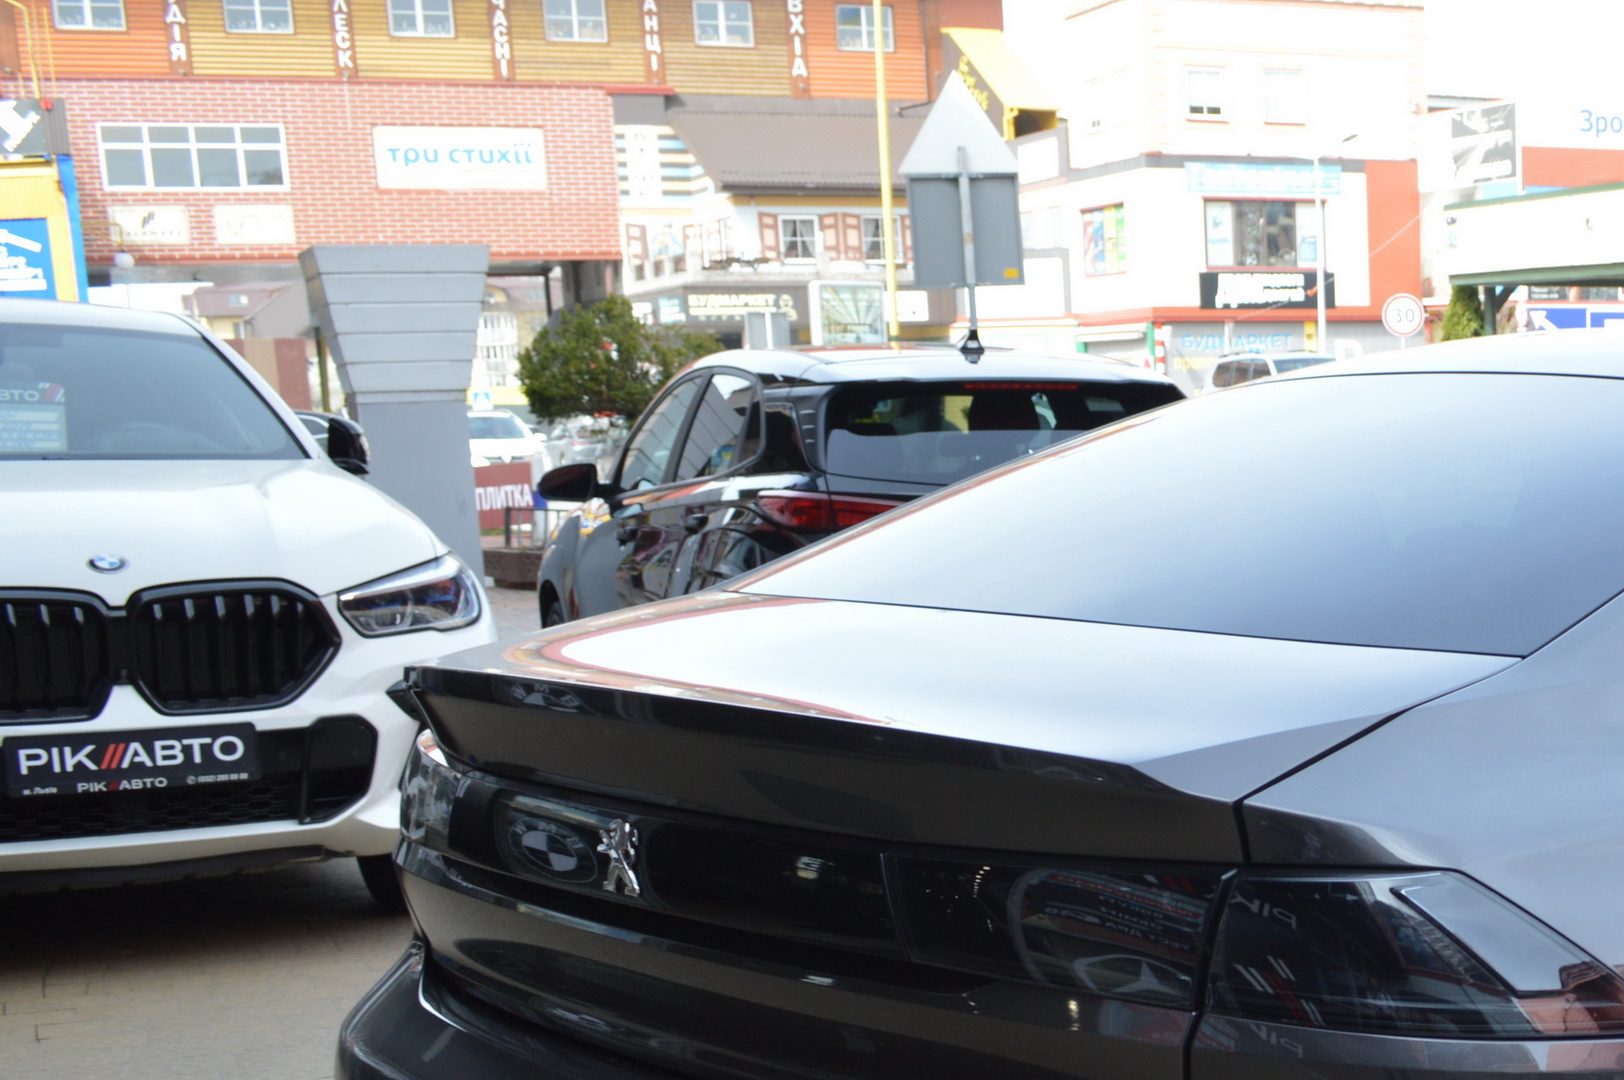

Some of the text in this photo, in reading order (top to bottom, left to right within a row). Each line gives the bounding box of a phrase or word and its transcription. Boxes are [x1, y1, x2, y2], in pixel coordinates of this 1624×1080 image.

[165, 0, 188, 62] ДІЯ
[387, 143, 532, 167] три стихії
[1394, 308, 1415, 323] 30
[474, 483, 534, 511] ПЛИТКА
